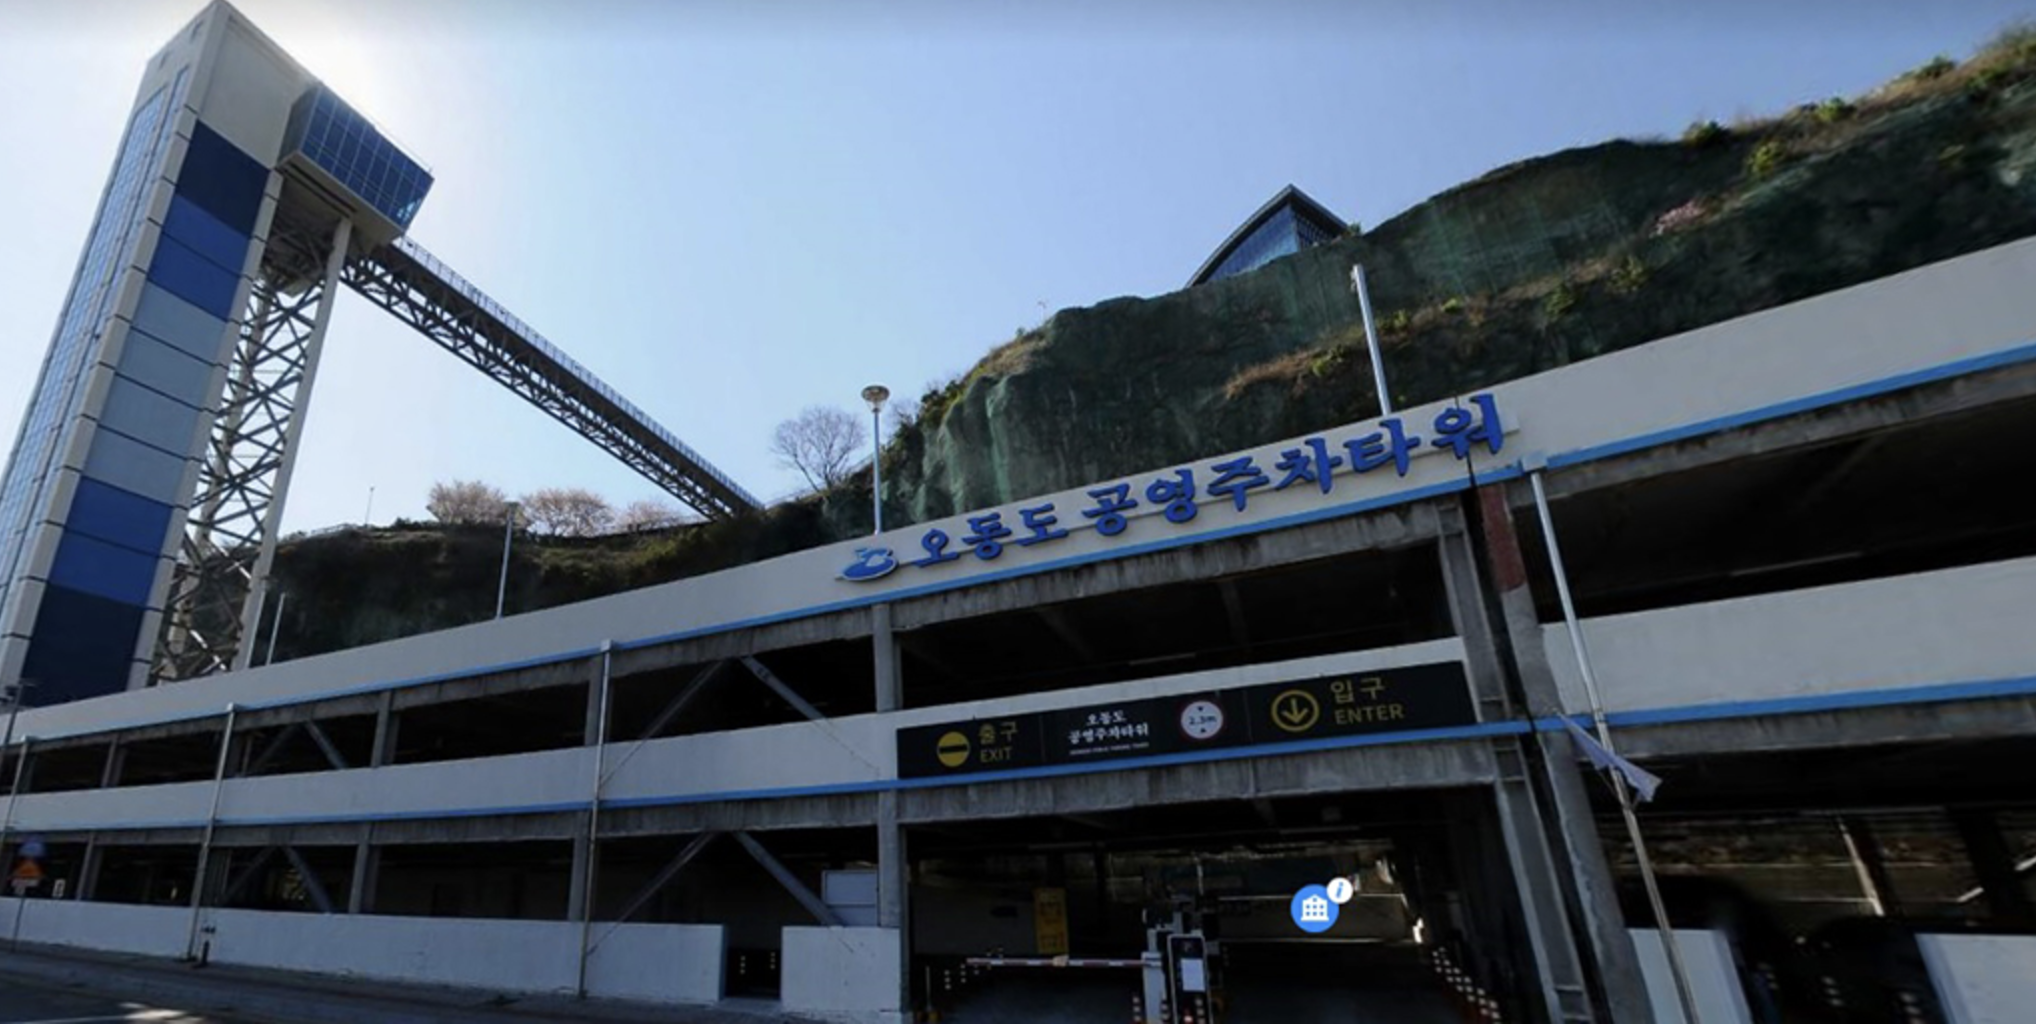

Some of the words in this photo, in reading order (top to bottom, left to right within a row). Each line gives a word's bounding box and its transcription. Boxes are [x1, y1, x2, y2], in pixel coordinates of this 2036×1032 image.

[912, 503, 1070, 569] 오동도
[1082, 393, 1506, 538] 공영주차타워
[1330, 676, 1386, 704] 입구
[1086, 709, 1127, 727] 오동도
[1334, 703, 1405, 726] ENTER
[977, 720, 1019, 746] 출구
[1067, 722, 1149, 745] 공영주차타워
[979, 746, 1014, 763] EXIT
